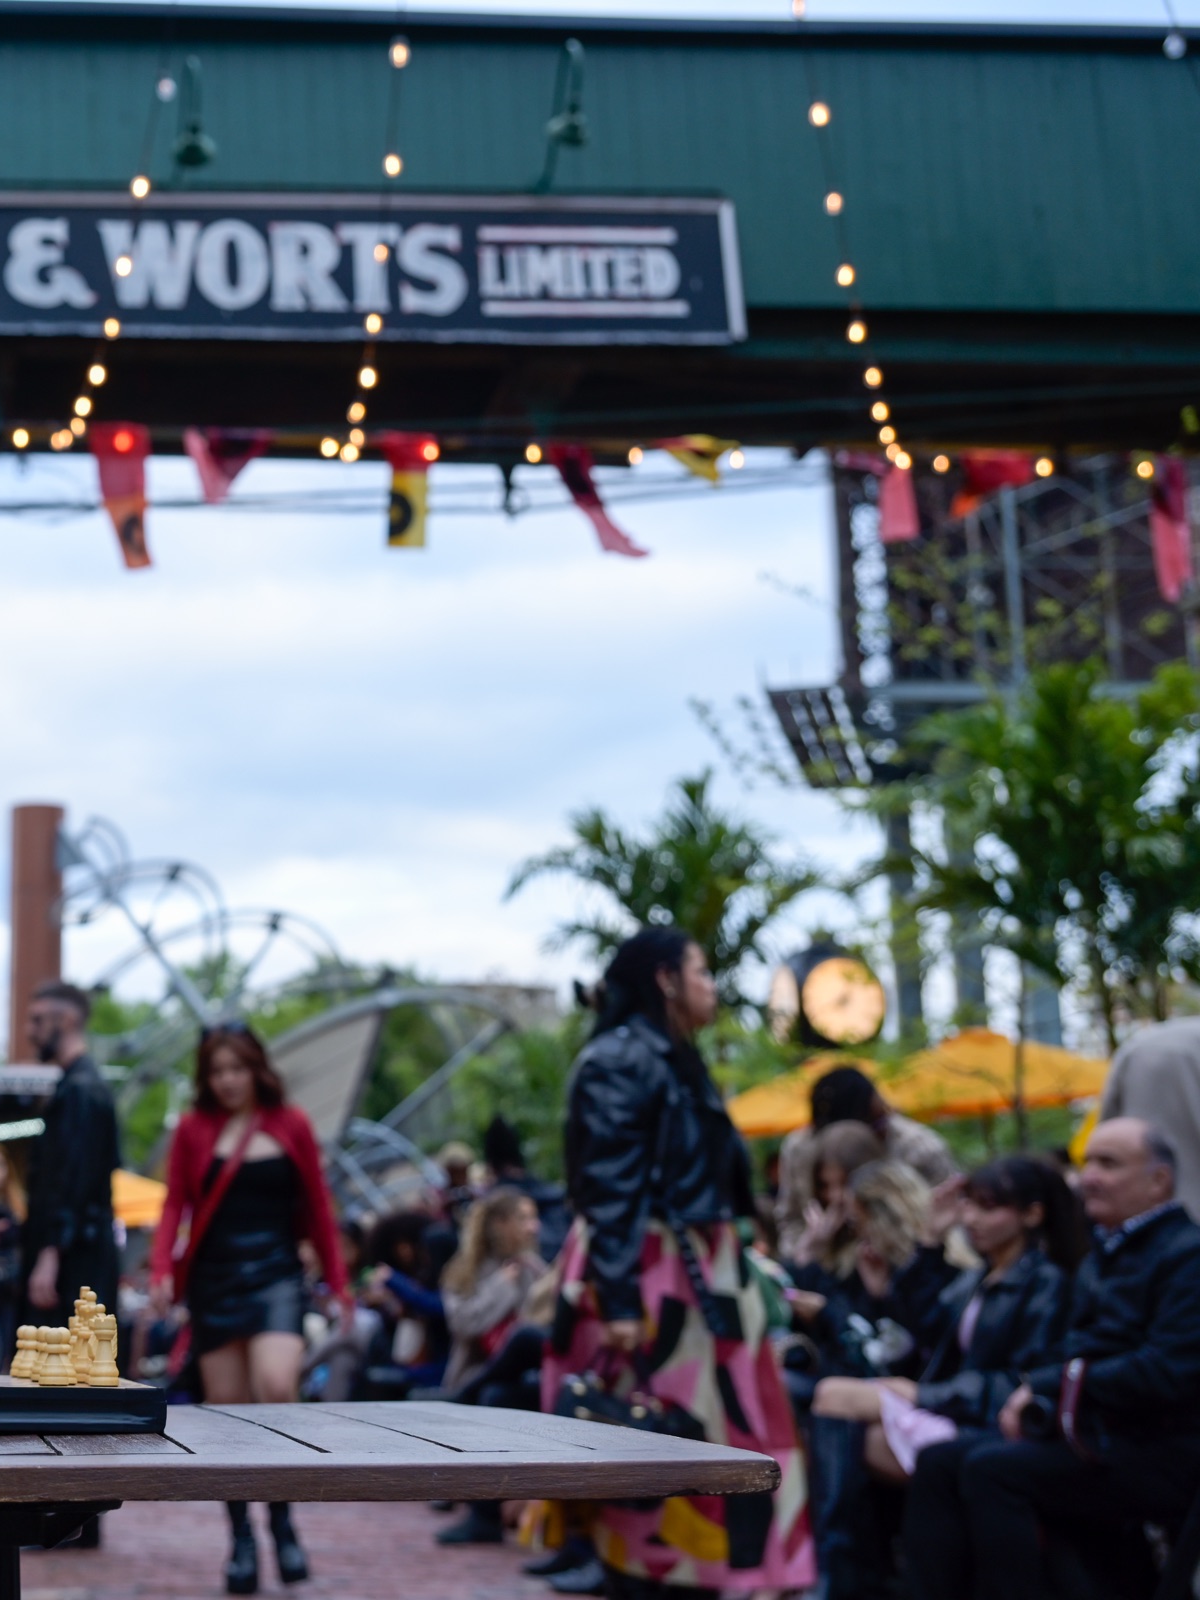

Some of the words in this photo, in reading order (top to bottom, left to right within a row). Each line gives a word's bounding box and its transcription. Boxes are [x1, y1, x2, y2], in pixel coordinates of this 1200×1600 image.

[3, 217, 96, 309] &
[97, 219, 468, 315] WORTS
[478, 245, 681, 300] LIMITED
